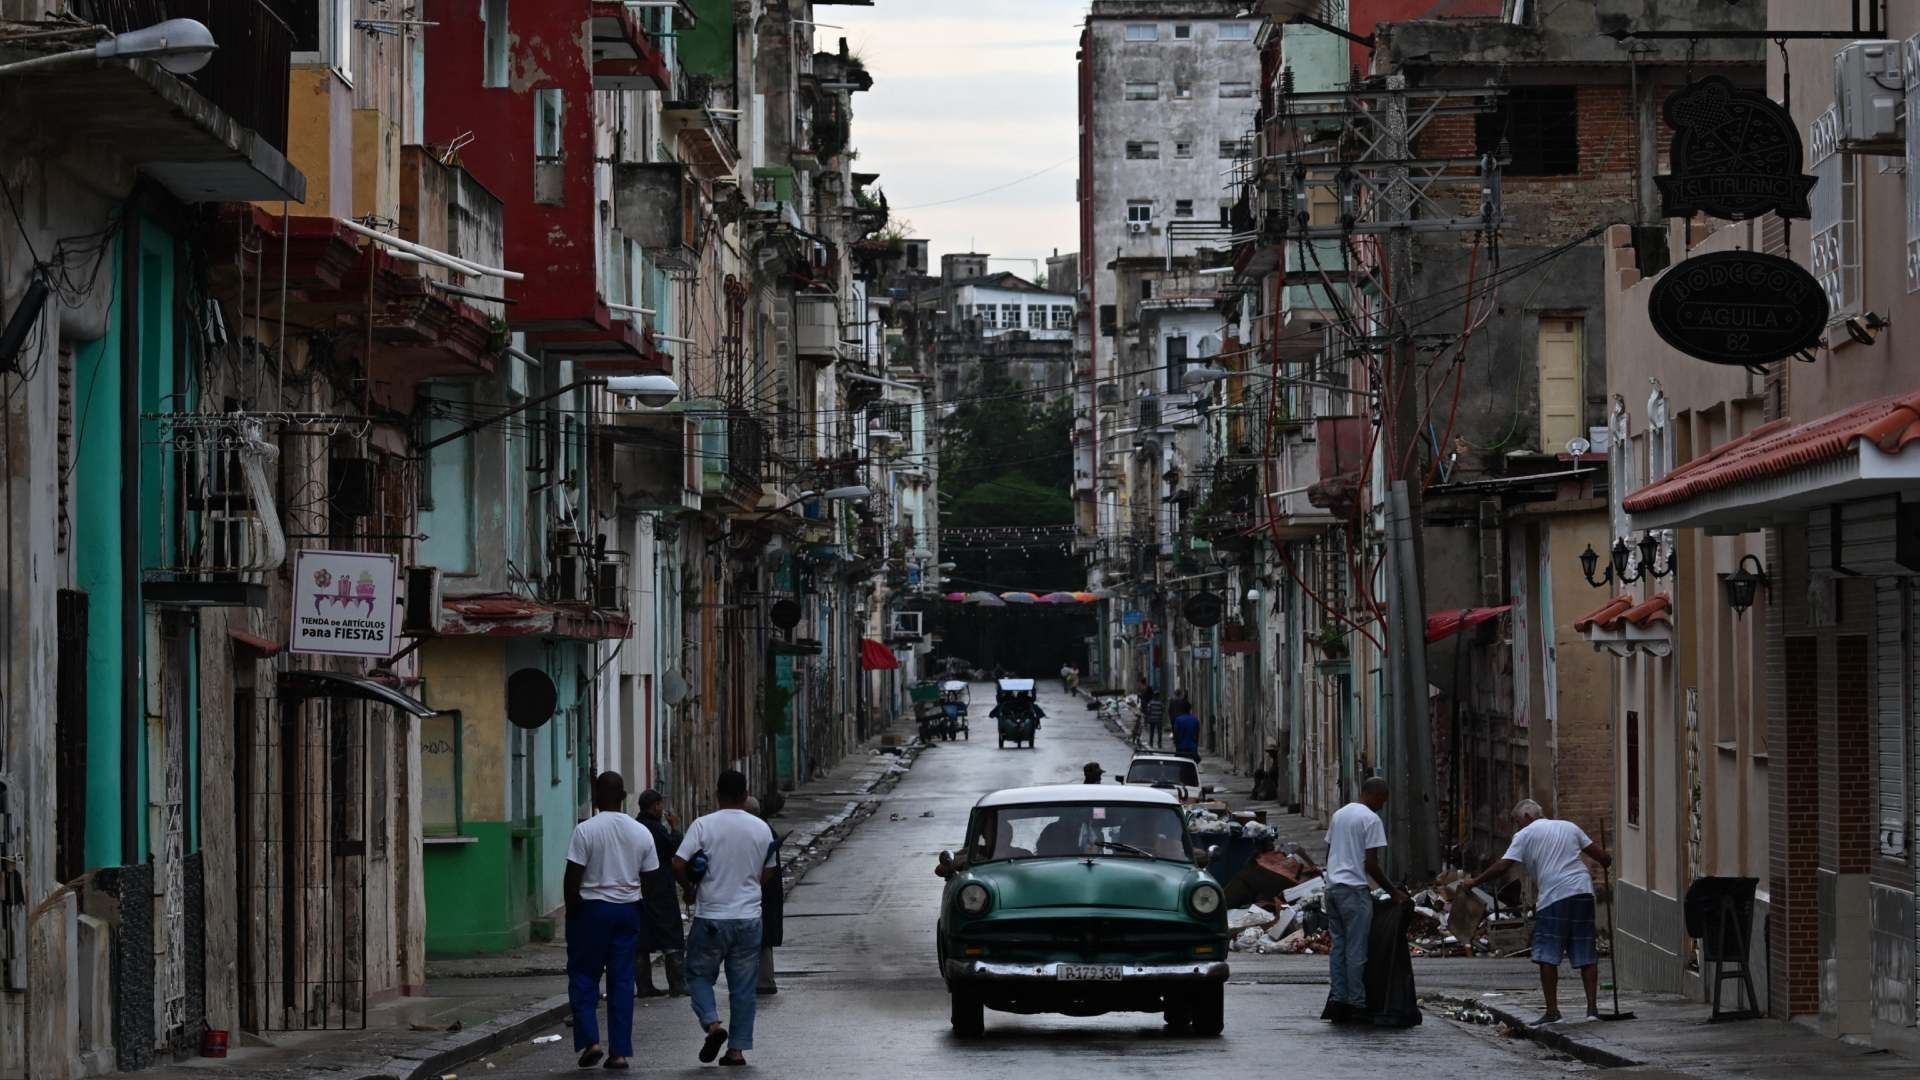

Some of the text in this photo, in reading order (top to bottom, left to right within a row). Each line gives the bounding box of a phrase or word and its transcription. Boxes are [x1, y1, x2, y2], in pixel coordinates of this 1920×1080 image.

[1710, 177, 1789, 195] ITALIANO
[1699, 308, 1778, 328] AGUILA
[1727, 333, 1750, 352] 62
[301, 617, 329, 625] TIENDA
[342, 618, 385, 629] ARTÍCULOS
[334, 627, 384, 640] FIESTAS
